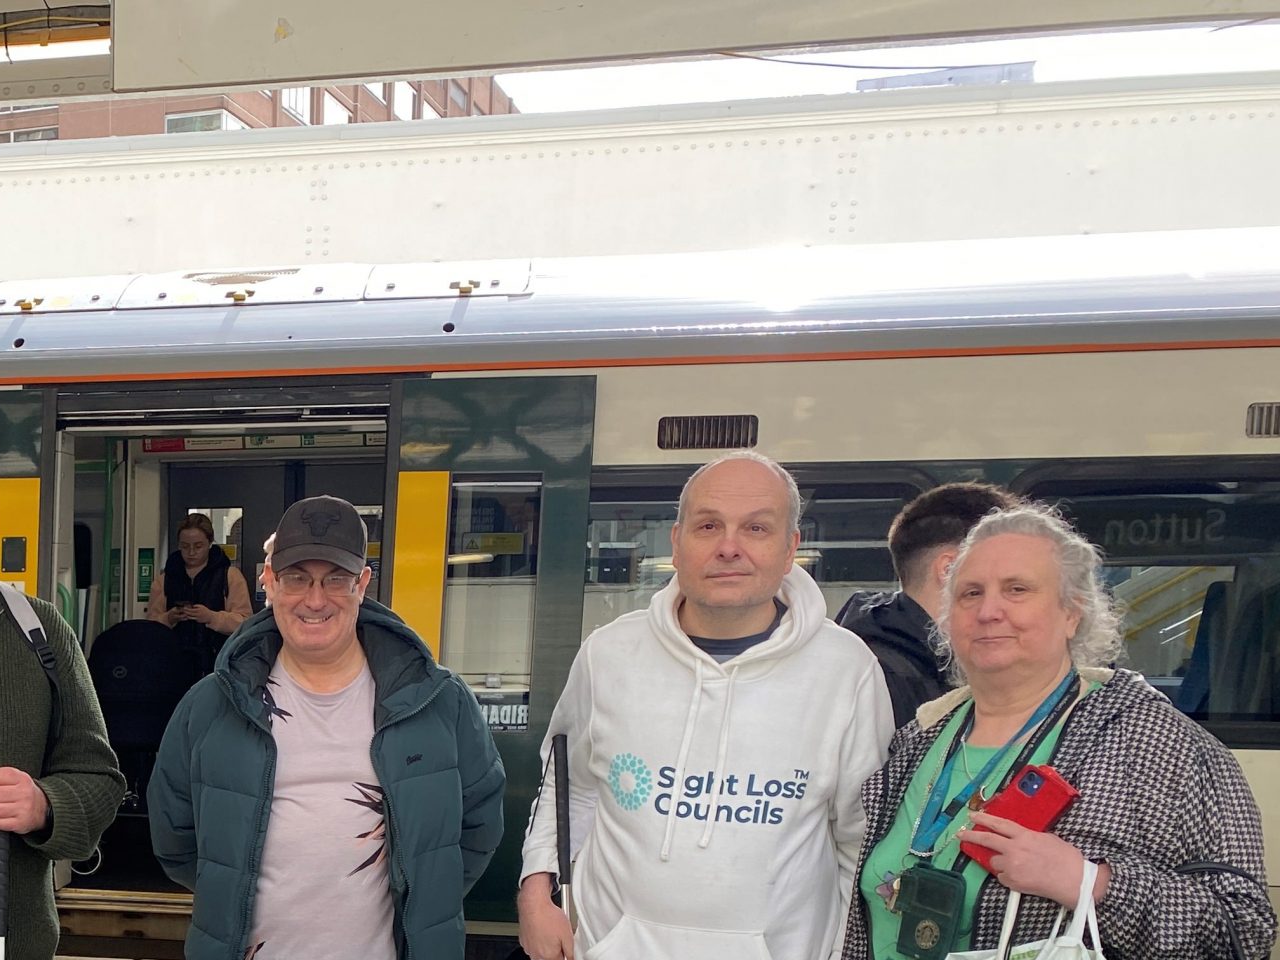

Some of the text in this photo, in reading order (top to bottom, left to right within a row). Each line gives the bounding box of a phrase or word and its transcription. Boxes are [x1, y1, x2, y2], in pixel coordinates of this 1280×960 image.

[657, 766, 738, 798] Sght
[746, 774, 807, 800] Loss
[654, 792, 784, 825] Councils
